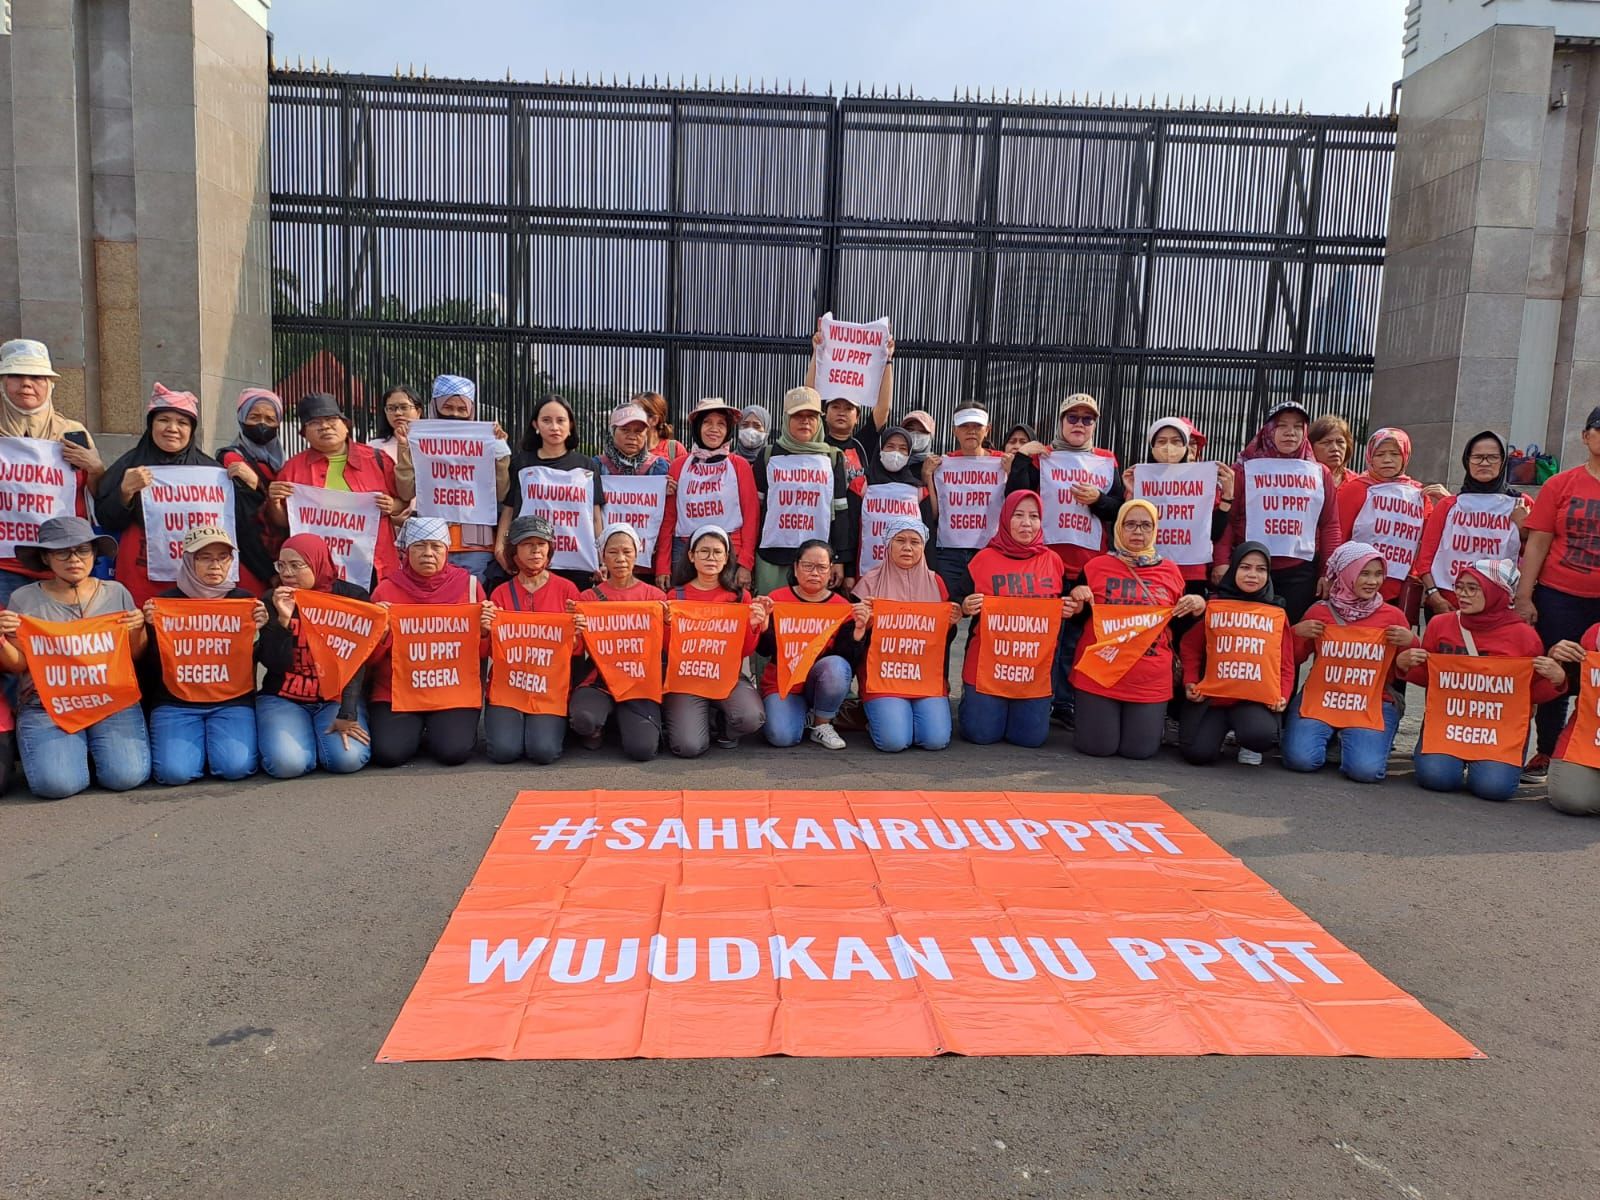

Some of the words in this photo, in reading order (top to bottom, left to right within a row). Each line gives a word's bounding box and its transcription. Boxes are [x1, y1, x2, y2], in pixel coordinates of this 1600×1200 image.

[829, 325, 882, 346] WUJUDKAN
[832, 348, 845, 362] UU
[847, 350, 872, 366] PPRT
[829, 368, 864, 388] SEGERA
[419, 439, 484, 457] WUJUDKAN
[0, 462, 64, 486] UJUDKAN
[432, 462, 447, 479] UU
[449, 465, 475, 481] PPRT
[773, 469, 828, 485] WUJUDKAN
[943, 471, 998, 485] WUJUDKAN
[1051, 468, 1107, 489] WUJUDKAN
[699, 479, 721, 495] PPRT
[1141, 480, 1203, 496] WUJUDKAN
[1254, 474, 1316, 490] WUJUDKAN
[152, 486, 225, 503] WUJUDKAN
[433, 488, 475, 507] SEGERA
[527, 483, 586, 503] WUJUDKAN
[779, 490, 793, 506] UU
[795, 490, 820, 507] PPRT
[949, 491, 963, 506] UU
[966, 491, 992, 507] PPRT
[1058, 488, 1073, 504] UU
[18, 493, 54, 514] PPRT
[686, 500, 724, 518] SEGERA
[1157, 505, 1164, 520] U
[1167, 504, 1195, 520] PPRT
[1263, 496, 1279, 510] UU
[1282, 496, 1310, 512] PPRT
[165, 513, 184, 531] UU
[188, 512, 218, 530] PPRT
[299, 507, 365, 532] WUJUDKAN
[552, 510, 580, 527] PPRT
[778, 513, 814, 531] SEGERA
[950, 514, 987, 530] SEGERA
[0, 522, 40, 542] SEGE
[185, 527, 229, 544] SPOR
[1155, 528, 1191, 545] EGERA
[1375, 518, 1391, 535] UU
[1393, 521, 1420, 541] PPRT
[553, 535, 578, 552] GERA
[1452, 534, 1470, 552] UU
[1472, 536, 1502, 555] PPRT
[992, 573, 1035, 596] PRT
[162, 615, 241, 633] WUJUDKAN
[301, 607, 373, 637] WUJUDKAN
[400, 617, 470, 635] WUJUDKAN
[587, 614, 650, 632] WUJUDKAN
[678, 618, 738, 633] WUJUDKAN
[779, 617, 836, 634] WUJUDKA
[876, 614, 936, 633] WUJUDKAN
[987, 615, 1049, 634] WUJUDKAN
[1210, 612, 1273, 633] WUJUDKAN
[498, 623, 562, 643] WUJUDKAN
[30, 632, 115, 656] WUJUDKAN
[174, 639, 192, 656] UU
[197, 639, 231, 655] PPRT
[409, 643, 427, 661] UU
[430, 642, 461, 659] PPRT
[597, 638, 613, 655] UU
[616, 638, 644, 654] PPRT
[681, 639, 696, 654] UU
[698, 638, 727, 655] PPRT
[785, 642, 799, 659] UU
[880, 637, 897, 654] UU
[898, 637, 926, 655] PPRT
[994, 639, 1009, 656] UU
[1012, 640, 1040, 659] PPRT
[1216, 636, 1233, 654] UU
[1235, 636, 1266, 656] PPRT
[1321, 640, 1385, 662] WUJUDKAN
[506, 646, 523, 664] UU
[525, 648, 553, 667] PPRT
[45, 665, 67, 687] UU
[71, 664, 108, 686] PPRT
[176, 664, 230, 683] SEGERA
[412, 668, 460, 689] SEGERA
[615, 661, 646, 678] ERA
[678, 660, 720, 680] SEGERA
[880, 661, 921, 681] SEGERA
[993, 663, 1035, 683] SEGERA
[1217, 661, 1262, 682] SEGERA
[1325, 665, 1343, 684] UU
[1344, 666, 1376, 686] PPRT
[509, 671, 547, 694] SEGERA
[1439, 671, 1514, 694] WUJUDKAN
[52, 693, 113, 714] SEGERA
[1322, 691, 1367, 711] SEGERA
[1446, 698, 1465, 717] UU
[1469, 700, 1503, 721] PPRT
[1446, 725, 1498, 745] SEGERA
[529, 817, 1183, 854] #SAHKANRUUPPRT
[467, 934, 954, 984] WUJUDKAN
[970, 937, 1097, 982] UU
[1107, 937, 1344, 984] PPRT
